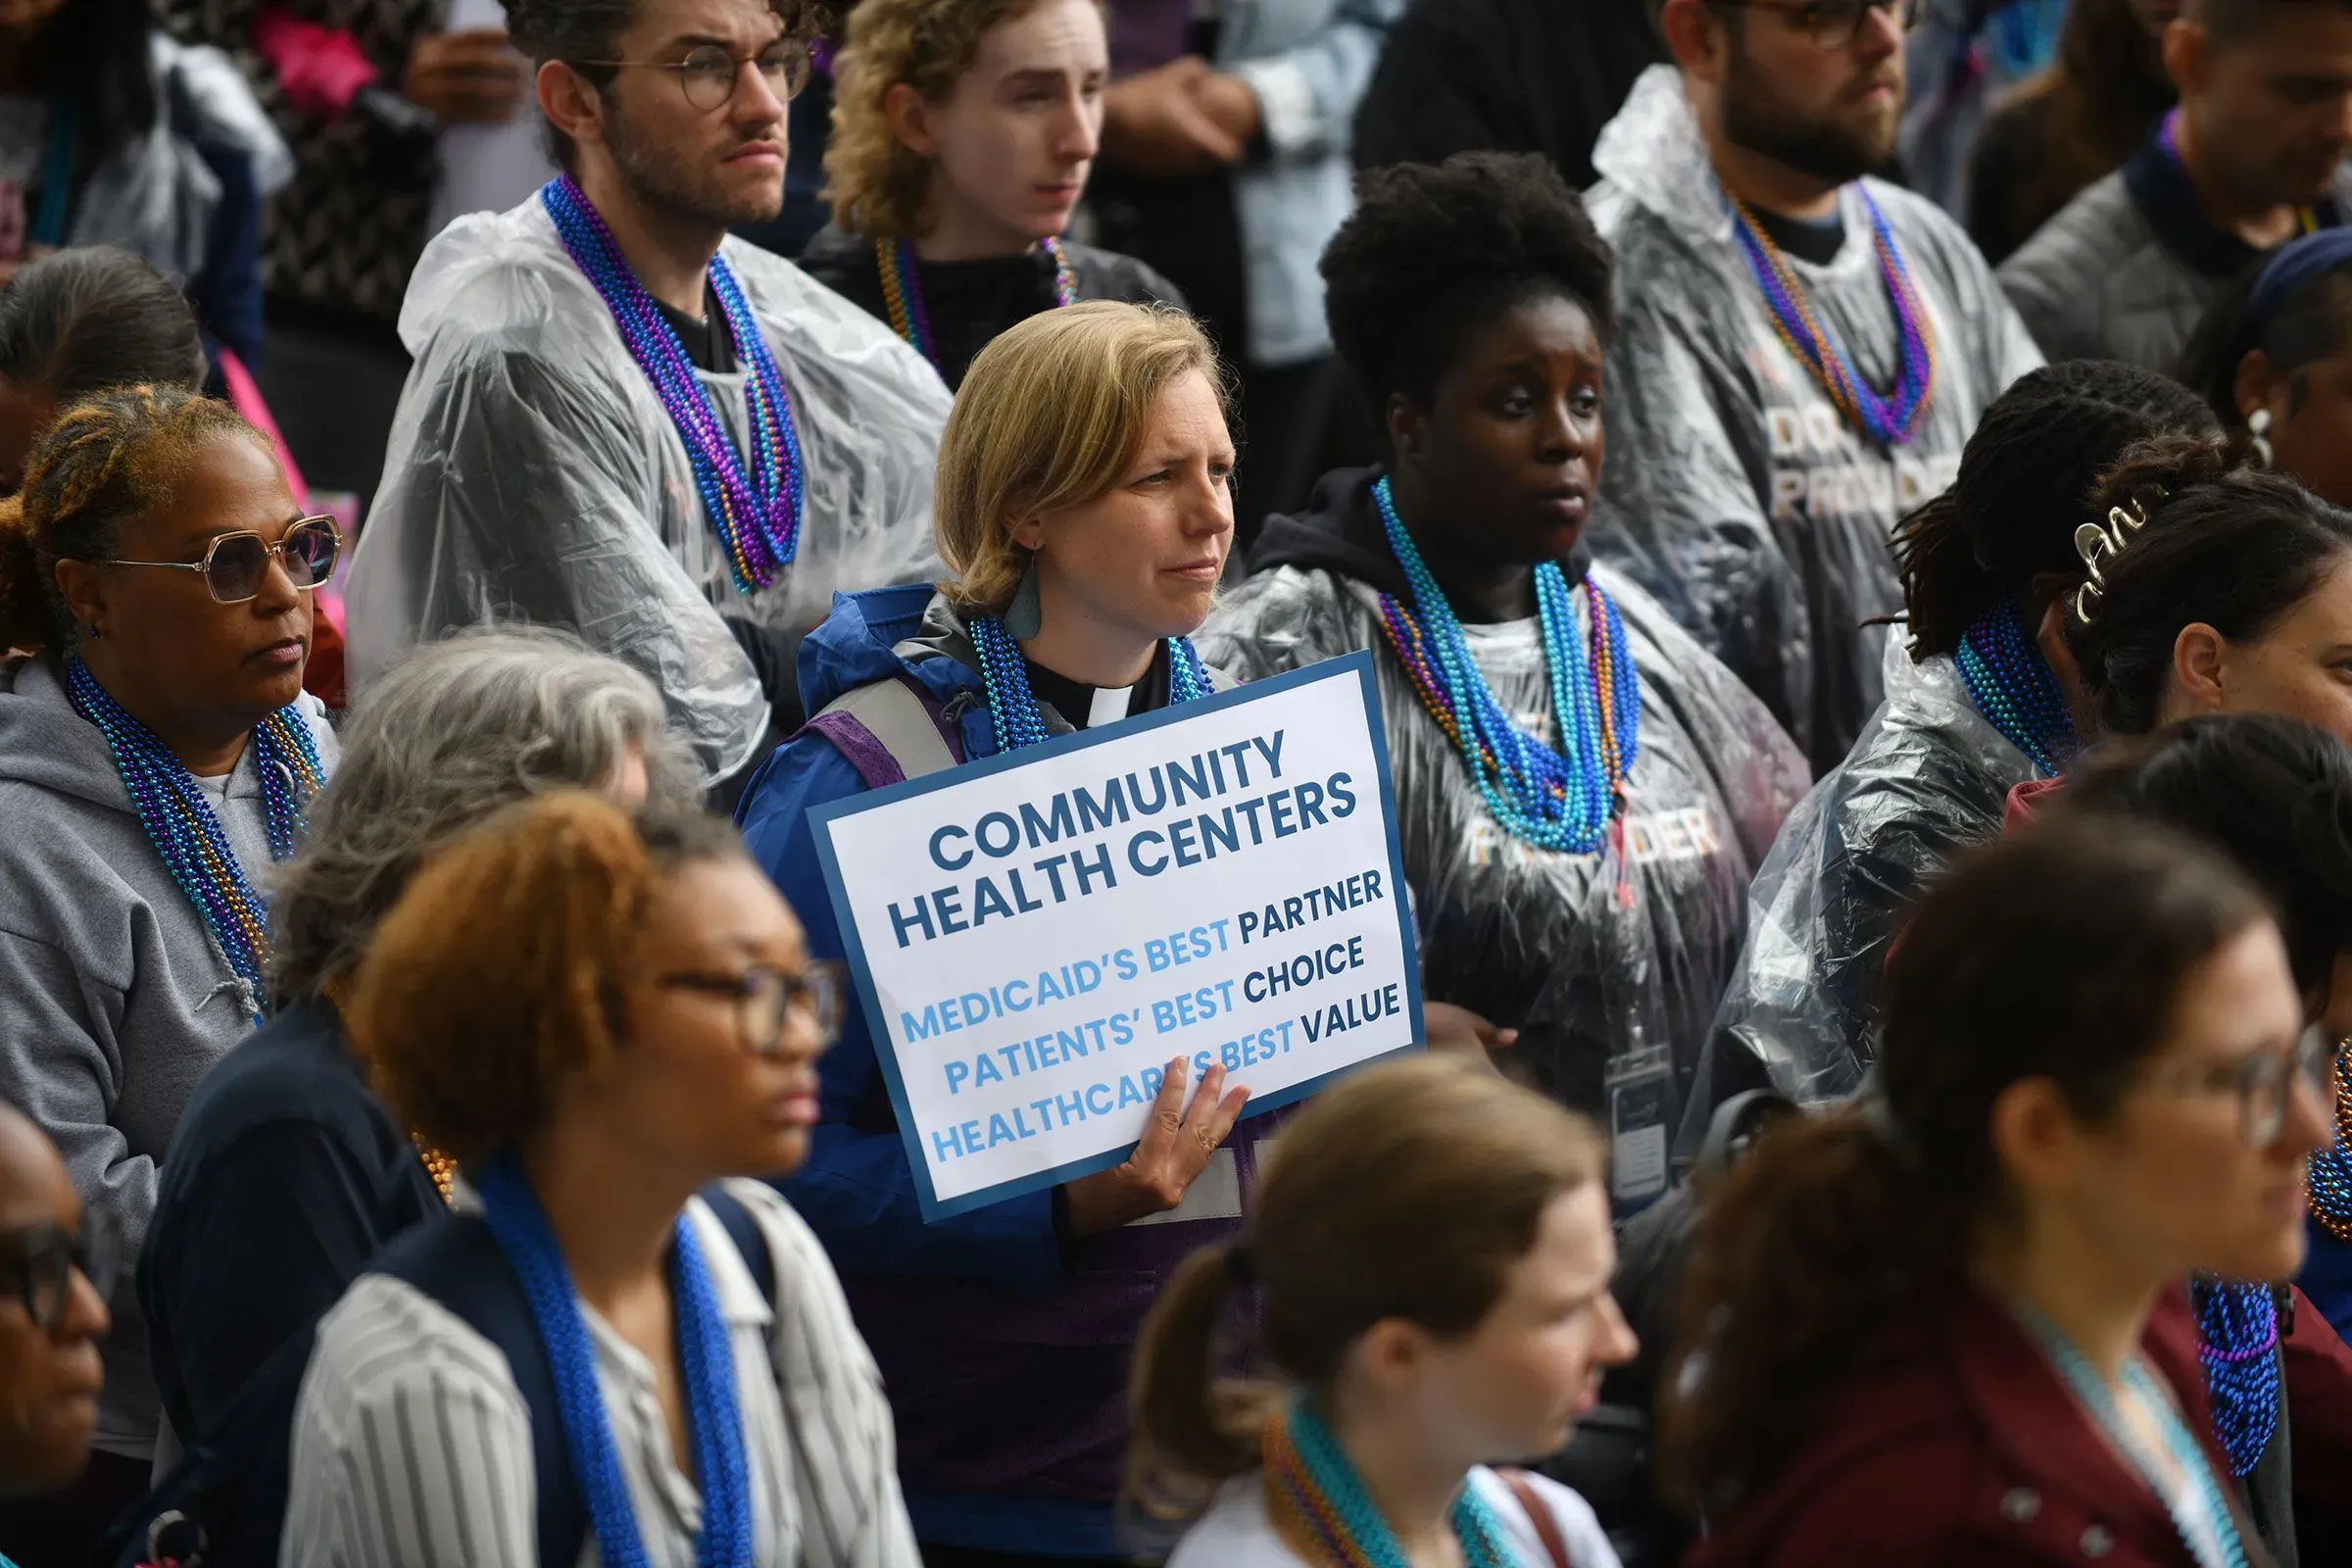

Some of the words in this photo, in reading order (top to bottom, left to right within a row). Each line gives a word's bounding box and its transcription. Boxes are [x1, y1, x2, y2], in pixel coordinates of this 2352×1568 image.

[887, 843, 1118, 949] HEALTH
[1128, 772, 1356, 877] CENTERS
[929, 729, 1285, 872] COMMUNITY
[900, 949, 1139, 1043] MEDICAID'S
[1145, 919, 1230, 973] BEST
[1238, 869, 1385, 946] PARTNER
[944, 1008, 1141, 1096] PATIENTS'
[1152, 980, 1235, 1035] BEST
[1243, 935, 1365, 1004] CHOICE
[931, 1051, 1212, 1163] HEALTHCAR'S
[1220, 1020, 1294, 1073] BEST
[1299, 983, 1400, 1044] VALUE
